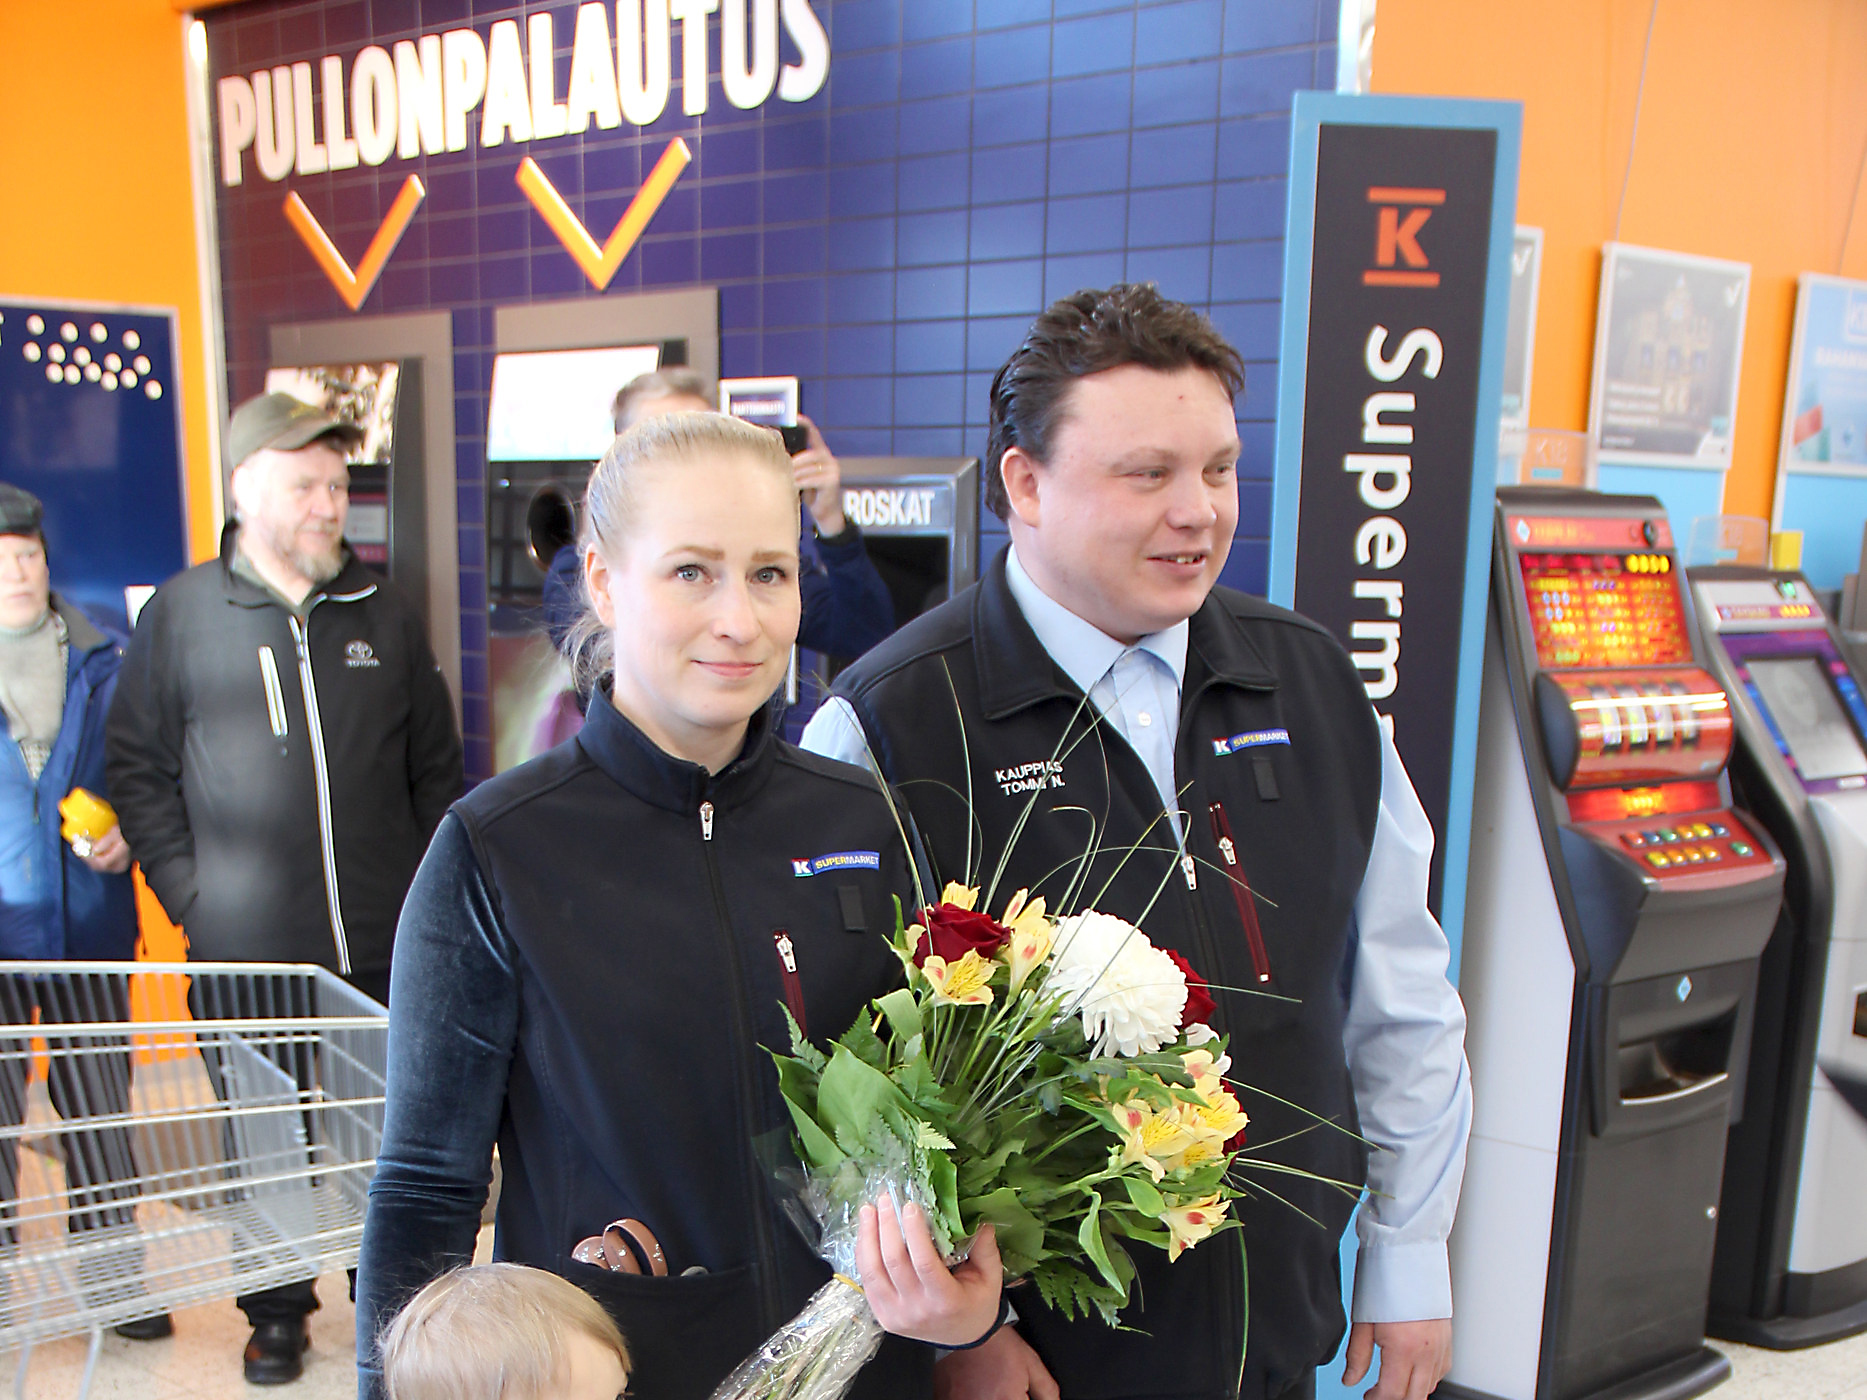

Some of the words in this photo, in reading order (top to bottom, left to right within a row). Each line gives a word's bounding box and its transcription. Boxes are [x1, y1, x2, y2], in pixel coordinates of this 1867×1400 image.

[217, 0, 831, 187] PULLONPALAUTUS
[1376, 206, 1432, 268] K
[843, 488, 936, 527] ROSKAT
[1342, 323, 1444, 742] Superm
[995, 761, 1064, 783] KAUPPIAS
[793, 861, 811, 874] K
[815, 855, 879, 870] SUPERMARKET
